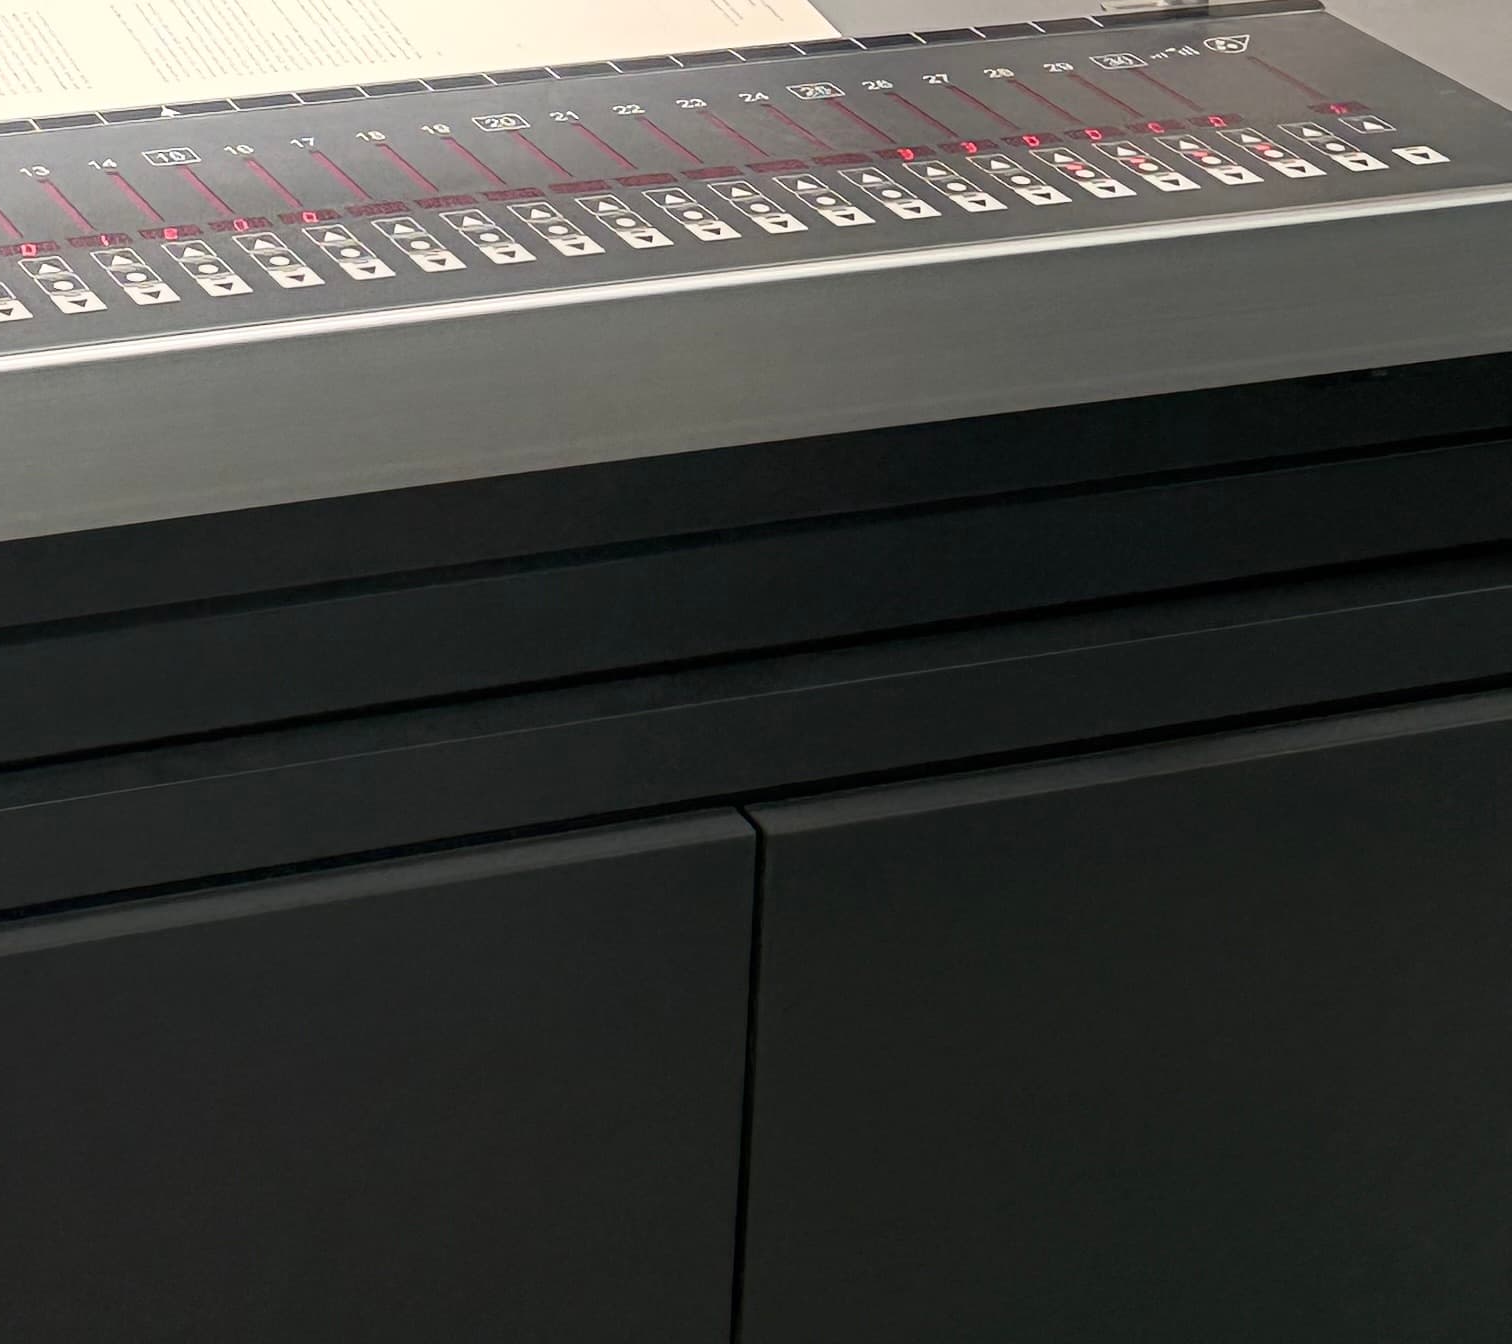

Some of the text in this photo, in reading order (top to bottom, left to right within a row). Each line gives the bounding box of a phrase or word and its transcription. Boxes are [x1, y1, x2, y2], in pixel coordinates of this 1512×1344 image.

[19, 166, 50, 177] 13
[88, 158, 118, 170] 14
[290, 137, 316, 148] 17
[550, 110, 579, 122] 21
[612, 103, 646, 115] 22
[922, 73, 950, 84] 27
